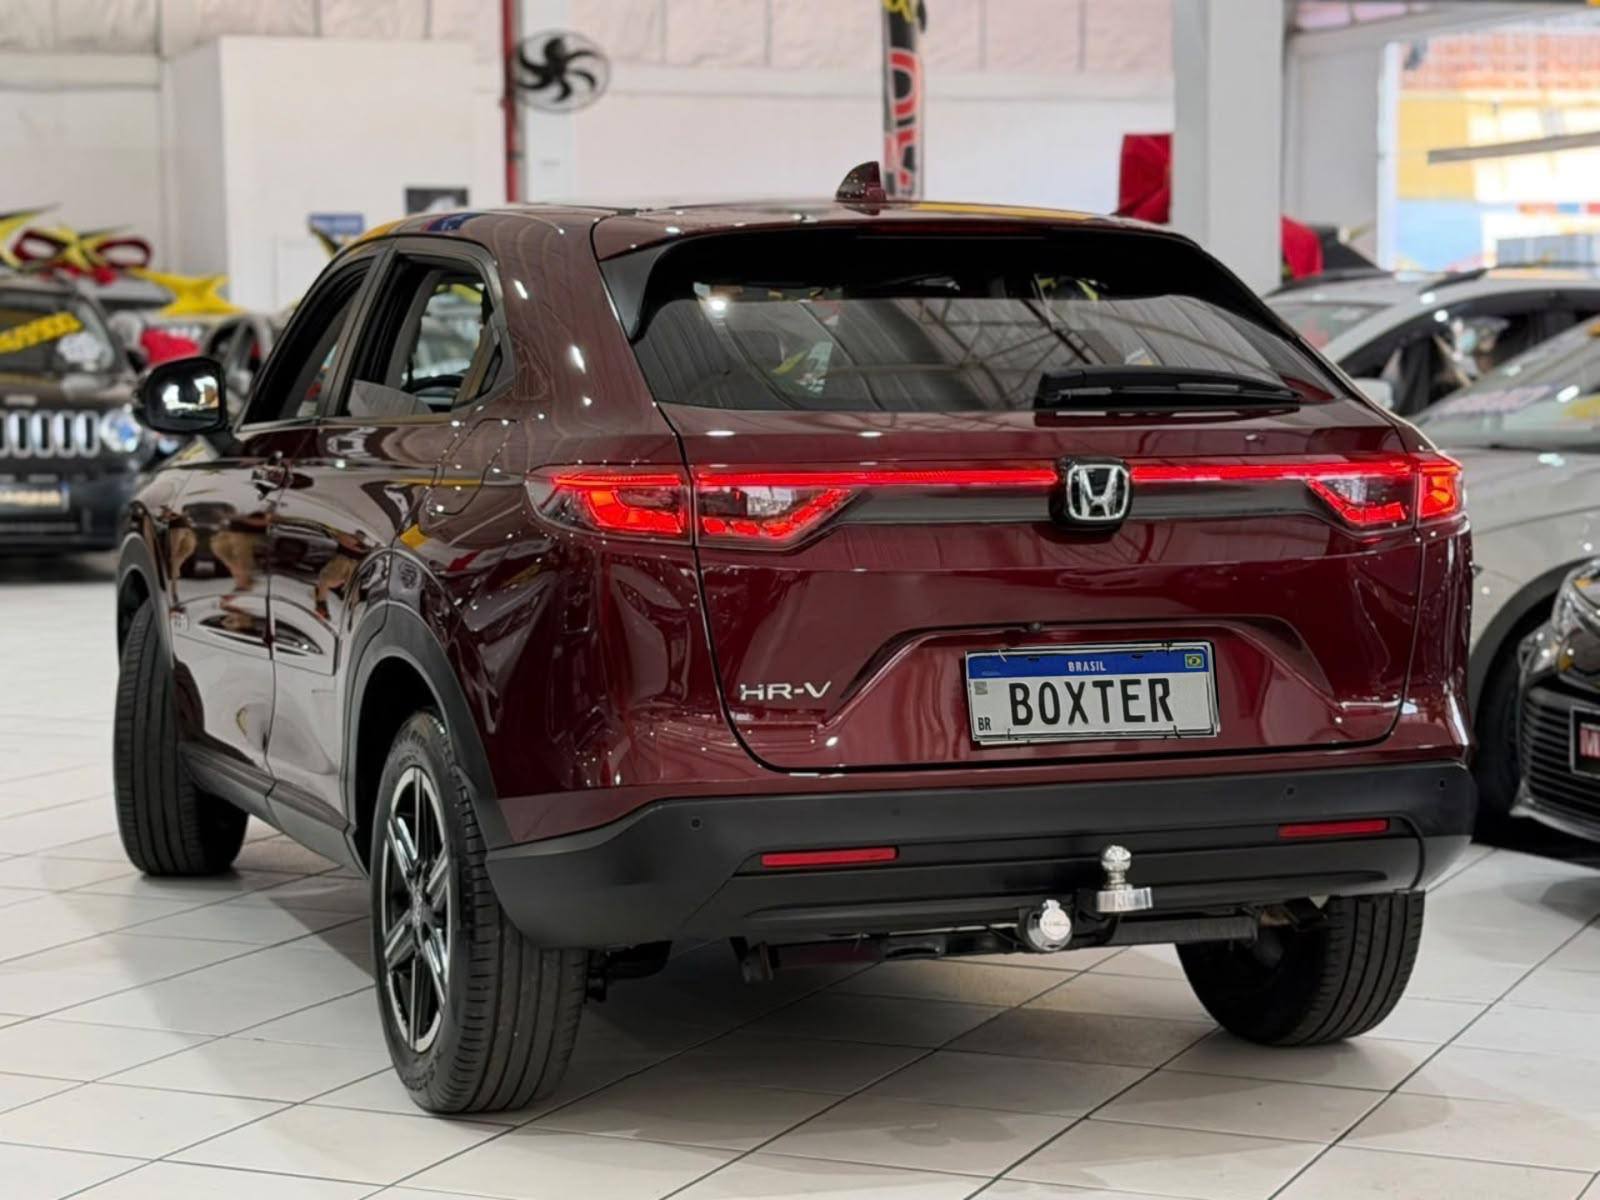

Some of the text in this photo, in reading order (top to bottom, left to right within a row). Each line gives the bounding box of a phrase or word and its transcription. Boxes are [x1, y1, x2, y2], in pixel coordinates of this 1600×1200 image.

[1067, 660, 1107, 673] BRASIL
[739, 680, 832, 701] HR-V
[1008, 677, 1174, 726] BOXTER
[977, 716, 992, 731] BR
